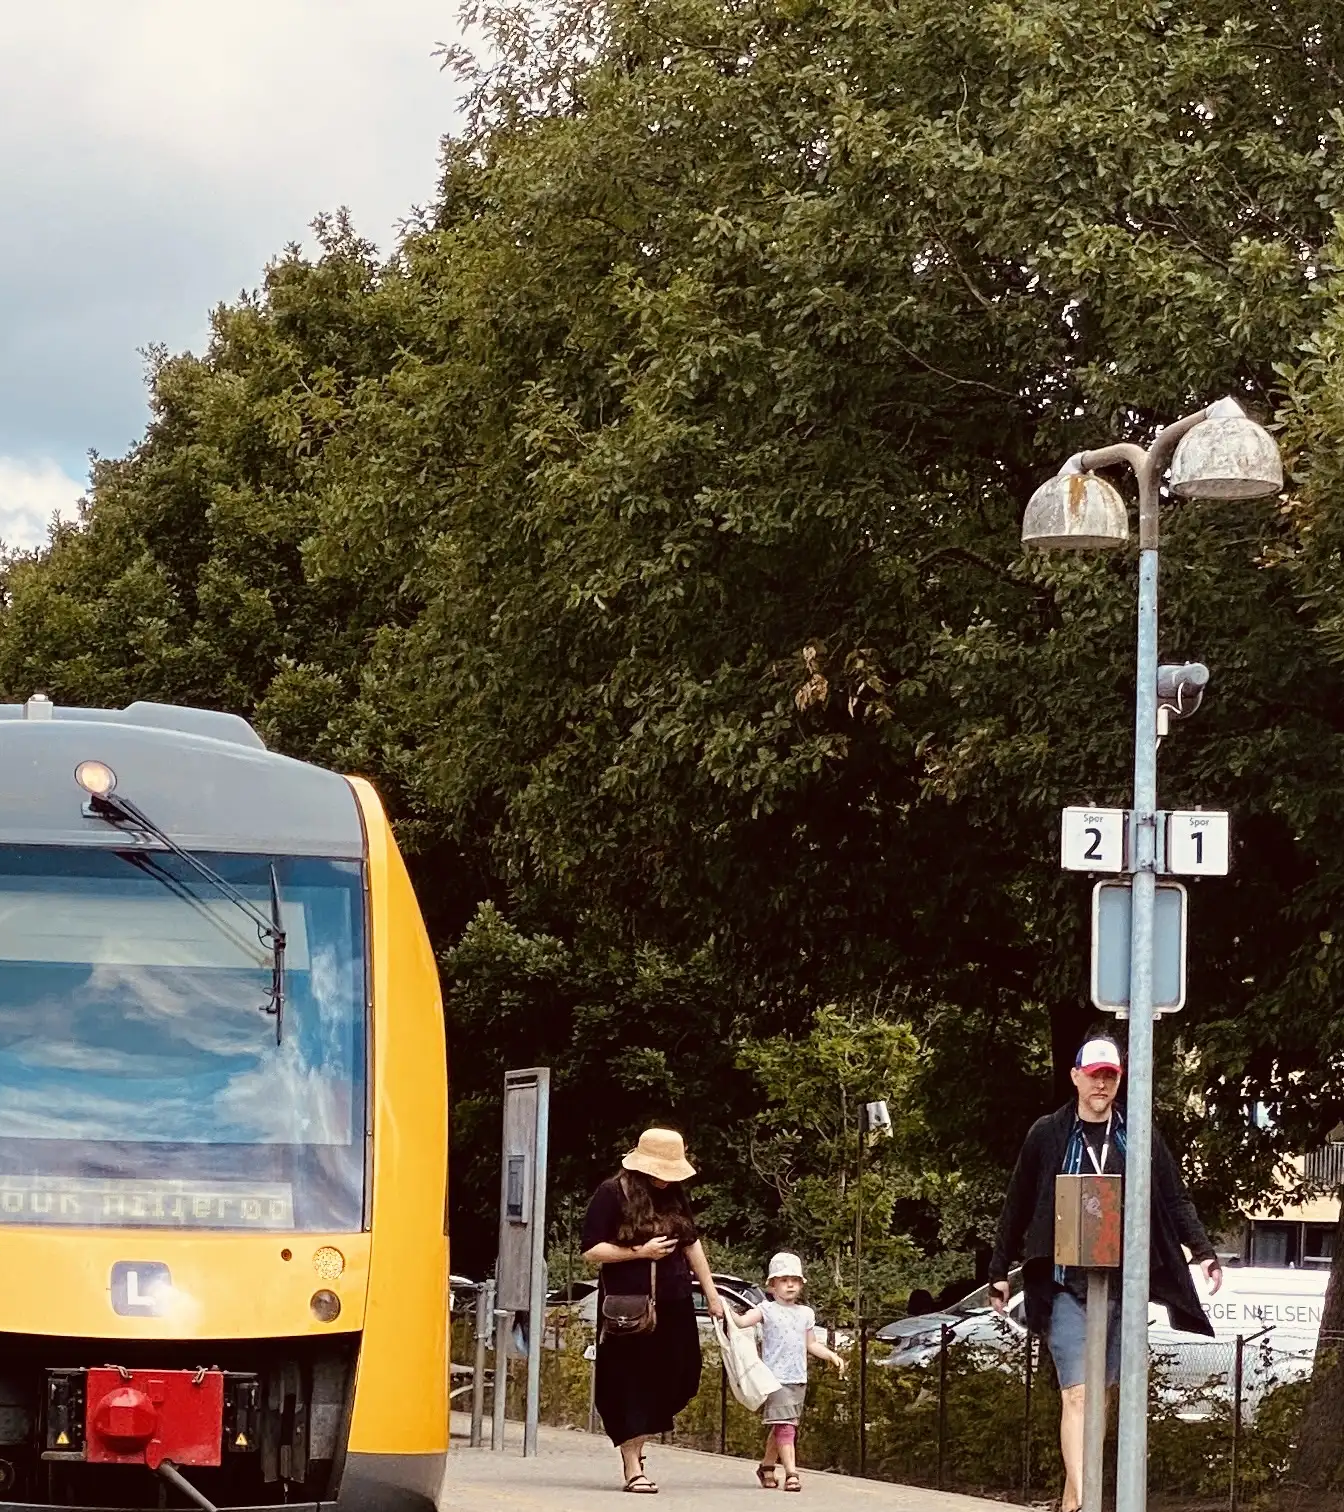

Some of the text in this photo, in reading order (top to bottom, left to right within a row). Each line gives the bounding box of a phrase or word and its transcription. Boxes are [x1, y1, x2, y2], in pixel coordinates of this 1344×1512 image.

[1083, 813, 1104, 824] Spor
[1189, 817, 1210, 828] Spor
[1083, 827, 1103, 861] 2
[1190, 831, 1204, 864] 1
[126, 1270, 157, 1306] L
[1200, 1303, 1321, 1323] RGE NELSEN
